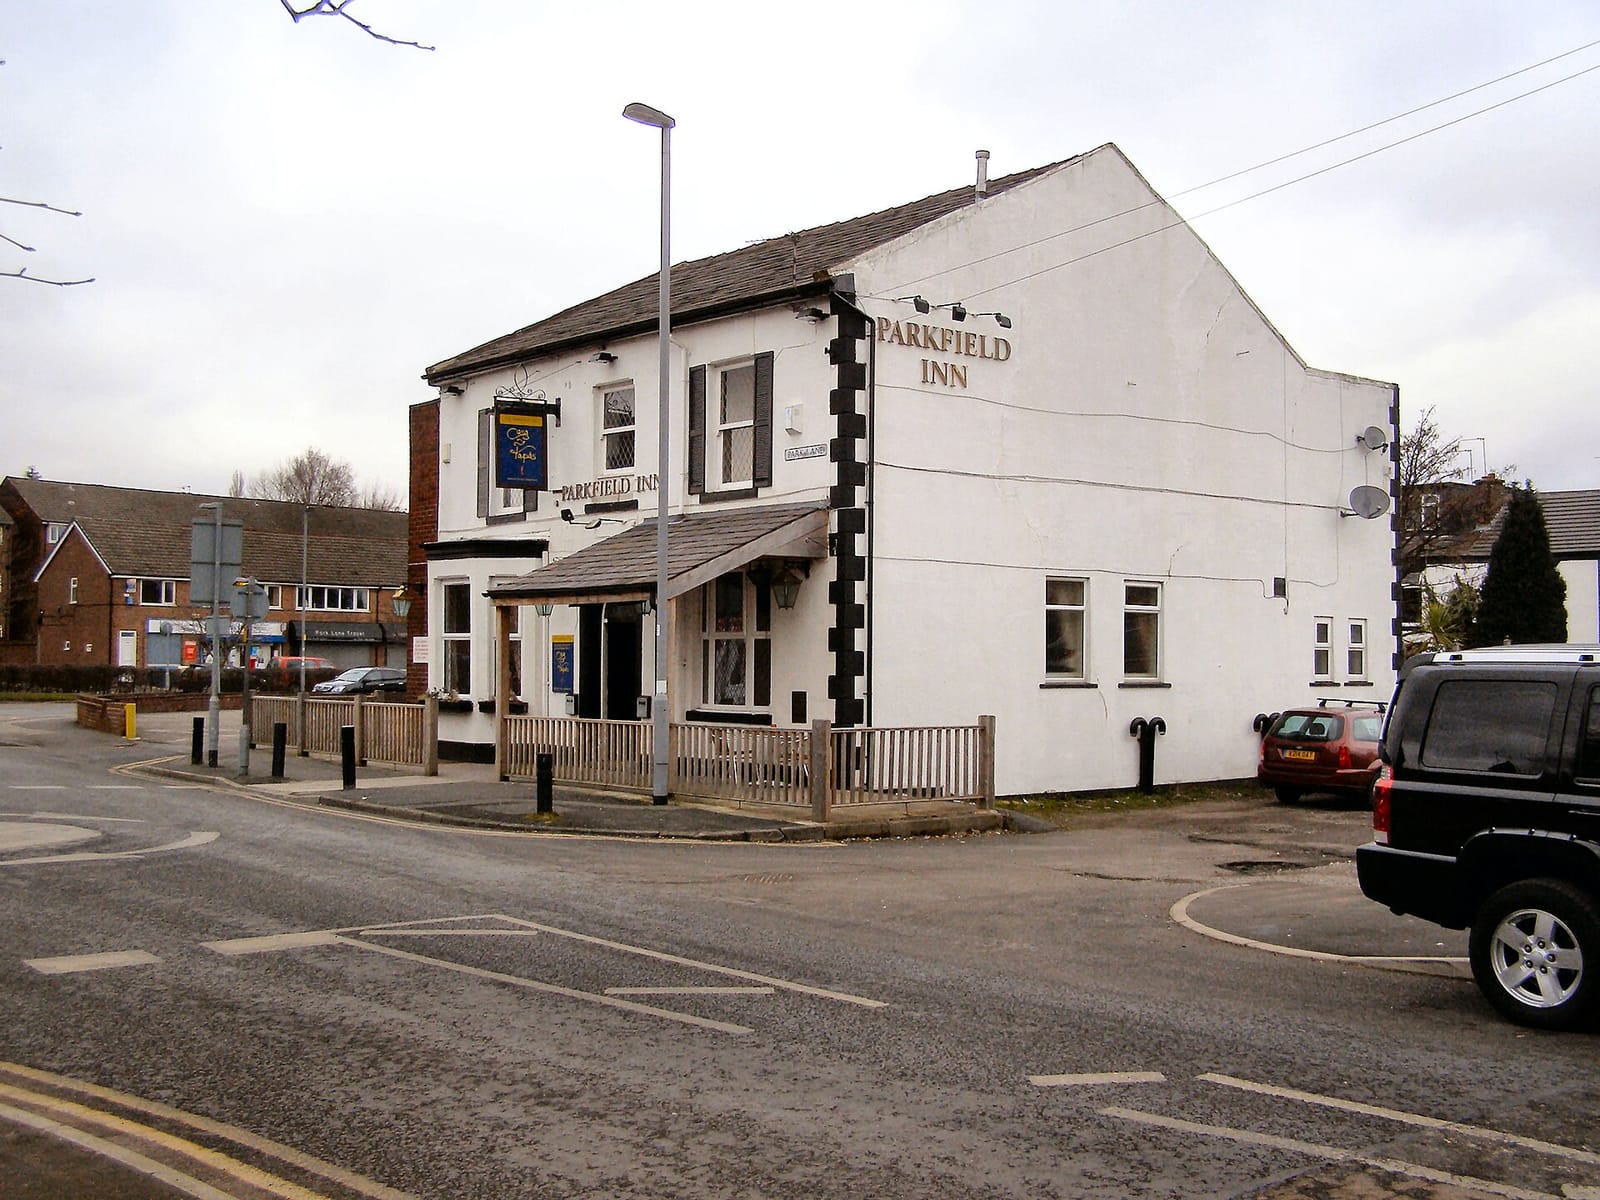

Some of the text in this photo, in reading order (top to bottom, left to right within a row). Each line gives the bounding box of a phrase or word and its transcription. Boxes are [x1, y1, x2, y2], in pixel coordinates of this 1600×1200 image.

[877, 316, 1012, 362] PARKFIELD
[921, 358, 968, 388] INN
[561, 478, 631, 501] PARKFIELD
